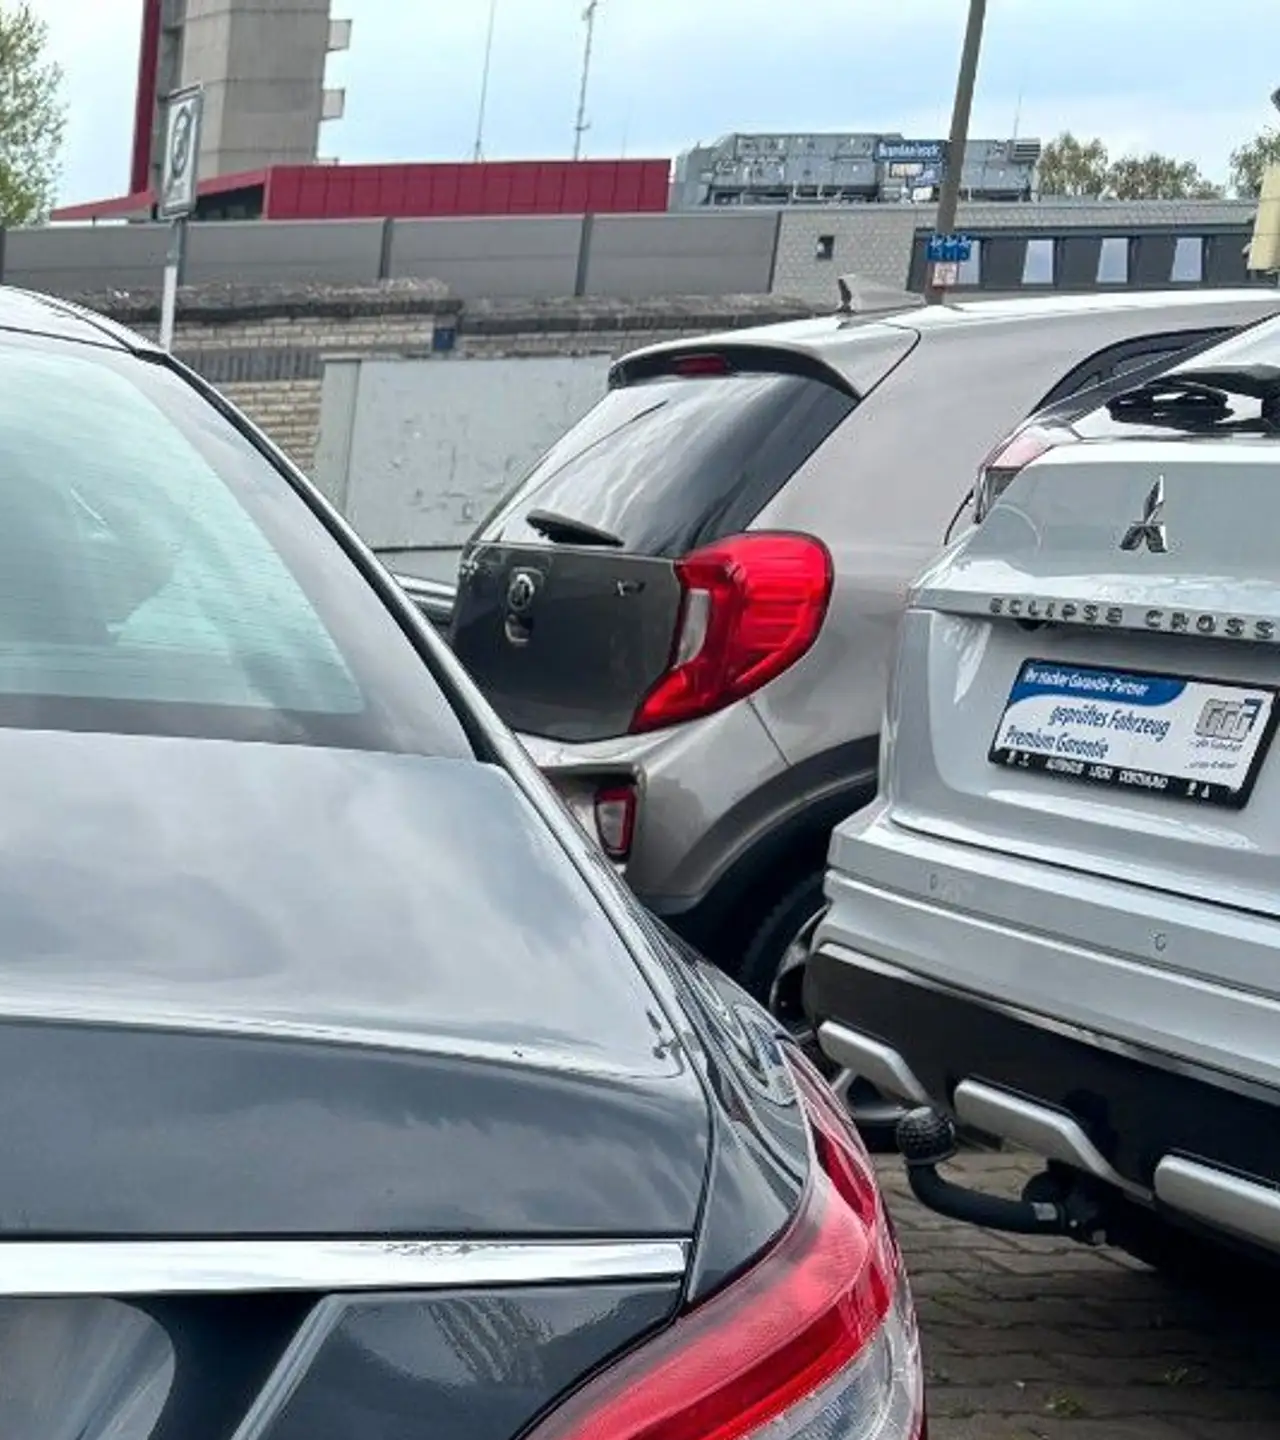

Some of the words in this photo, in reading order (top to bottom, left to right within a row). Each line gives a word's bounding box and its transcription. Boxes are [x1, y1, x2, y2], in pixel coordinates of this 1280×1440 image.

[990, 598, 1124, 625] ECLIPSE
[1145, 609, 1275, 640] CROSS
[1004, 725, 1056, 750] Premium
[1055, 732, 1109, 759] Garantie
[1108, 709, 1172, 742] Fahrzeug
